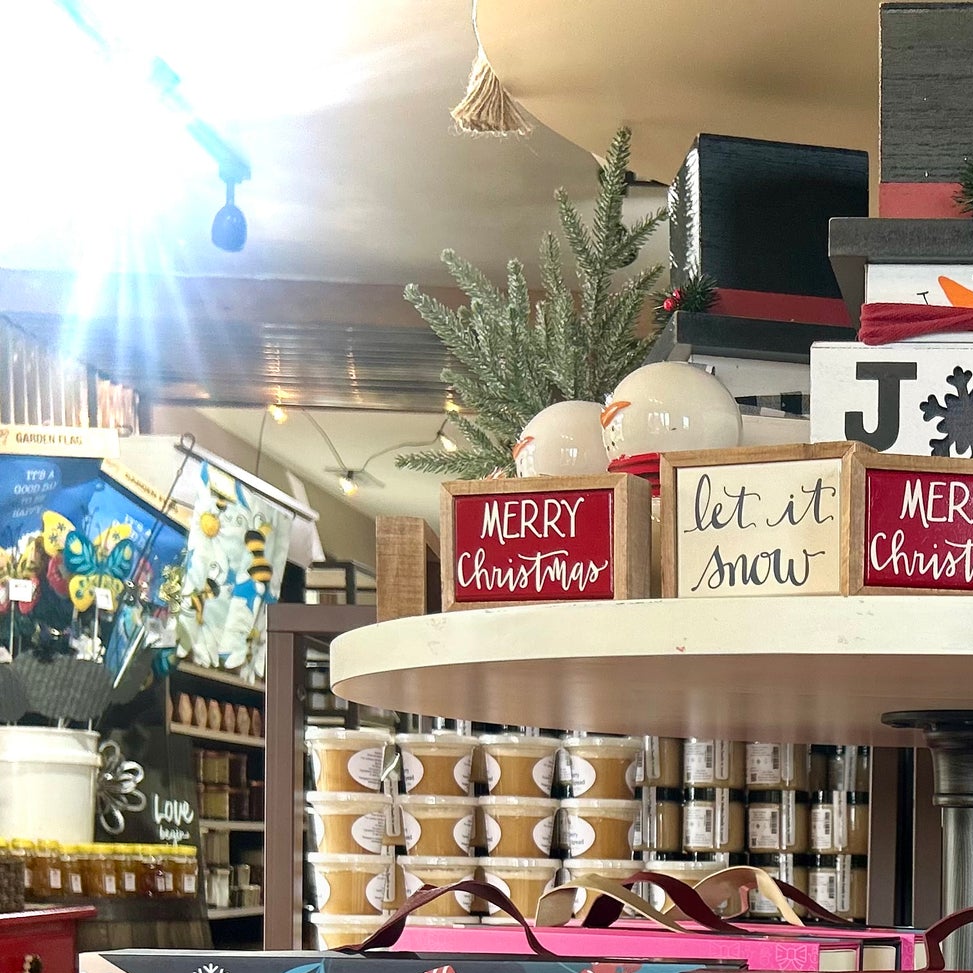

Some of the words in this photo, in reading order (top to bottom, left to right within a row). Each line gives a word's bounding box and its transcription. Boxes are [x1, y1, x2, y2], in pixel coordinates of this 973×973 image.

[15, 432, 56, 445] GARDEN
[480, 497, 585, 545] MERRY
[684, 473, 761, 533] let
[766, 477, 836, 528] it
[457, 548, 609, 593] Christmas
[691, 545, 825, 592] snow
[154, 793, 194, 826] Love
